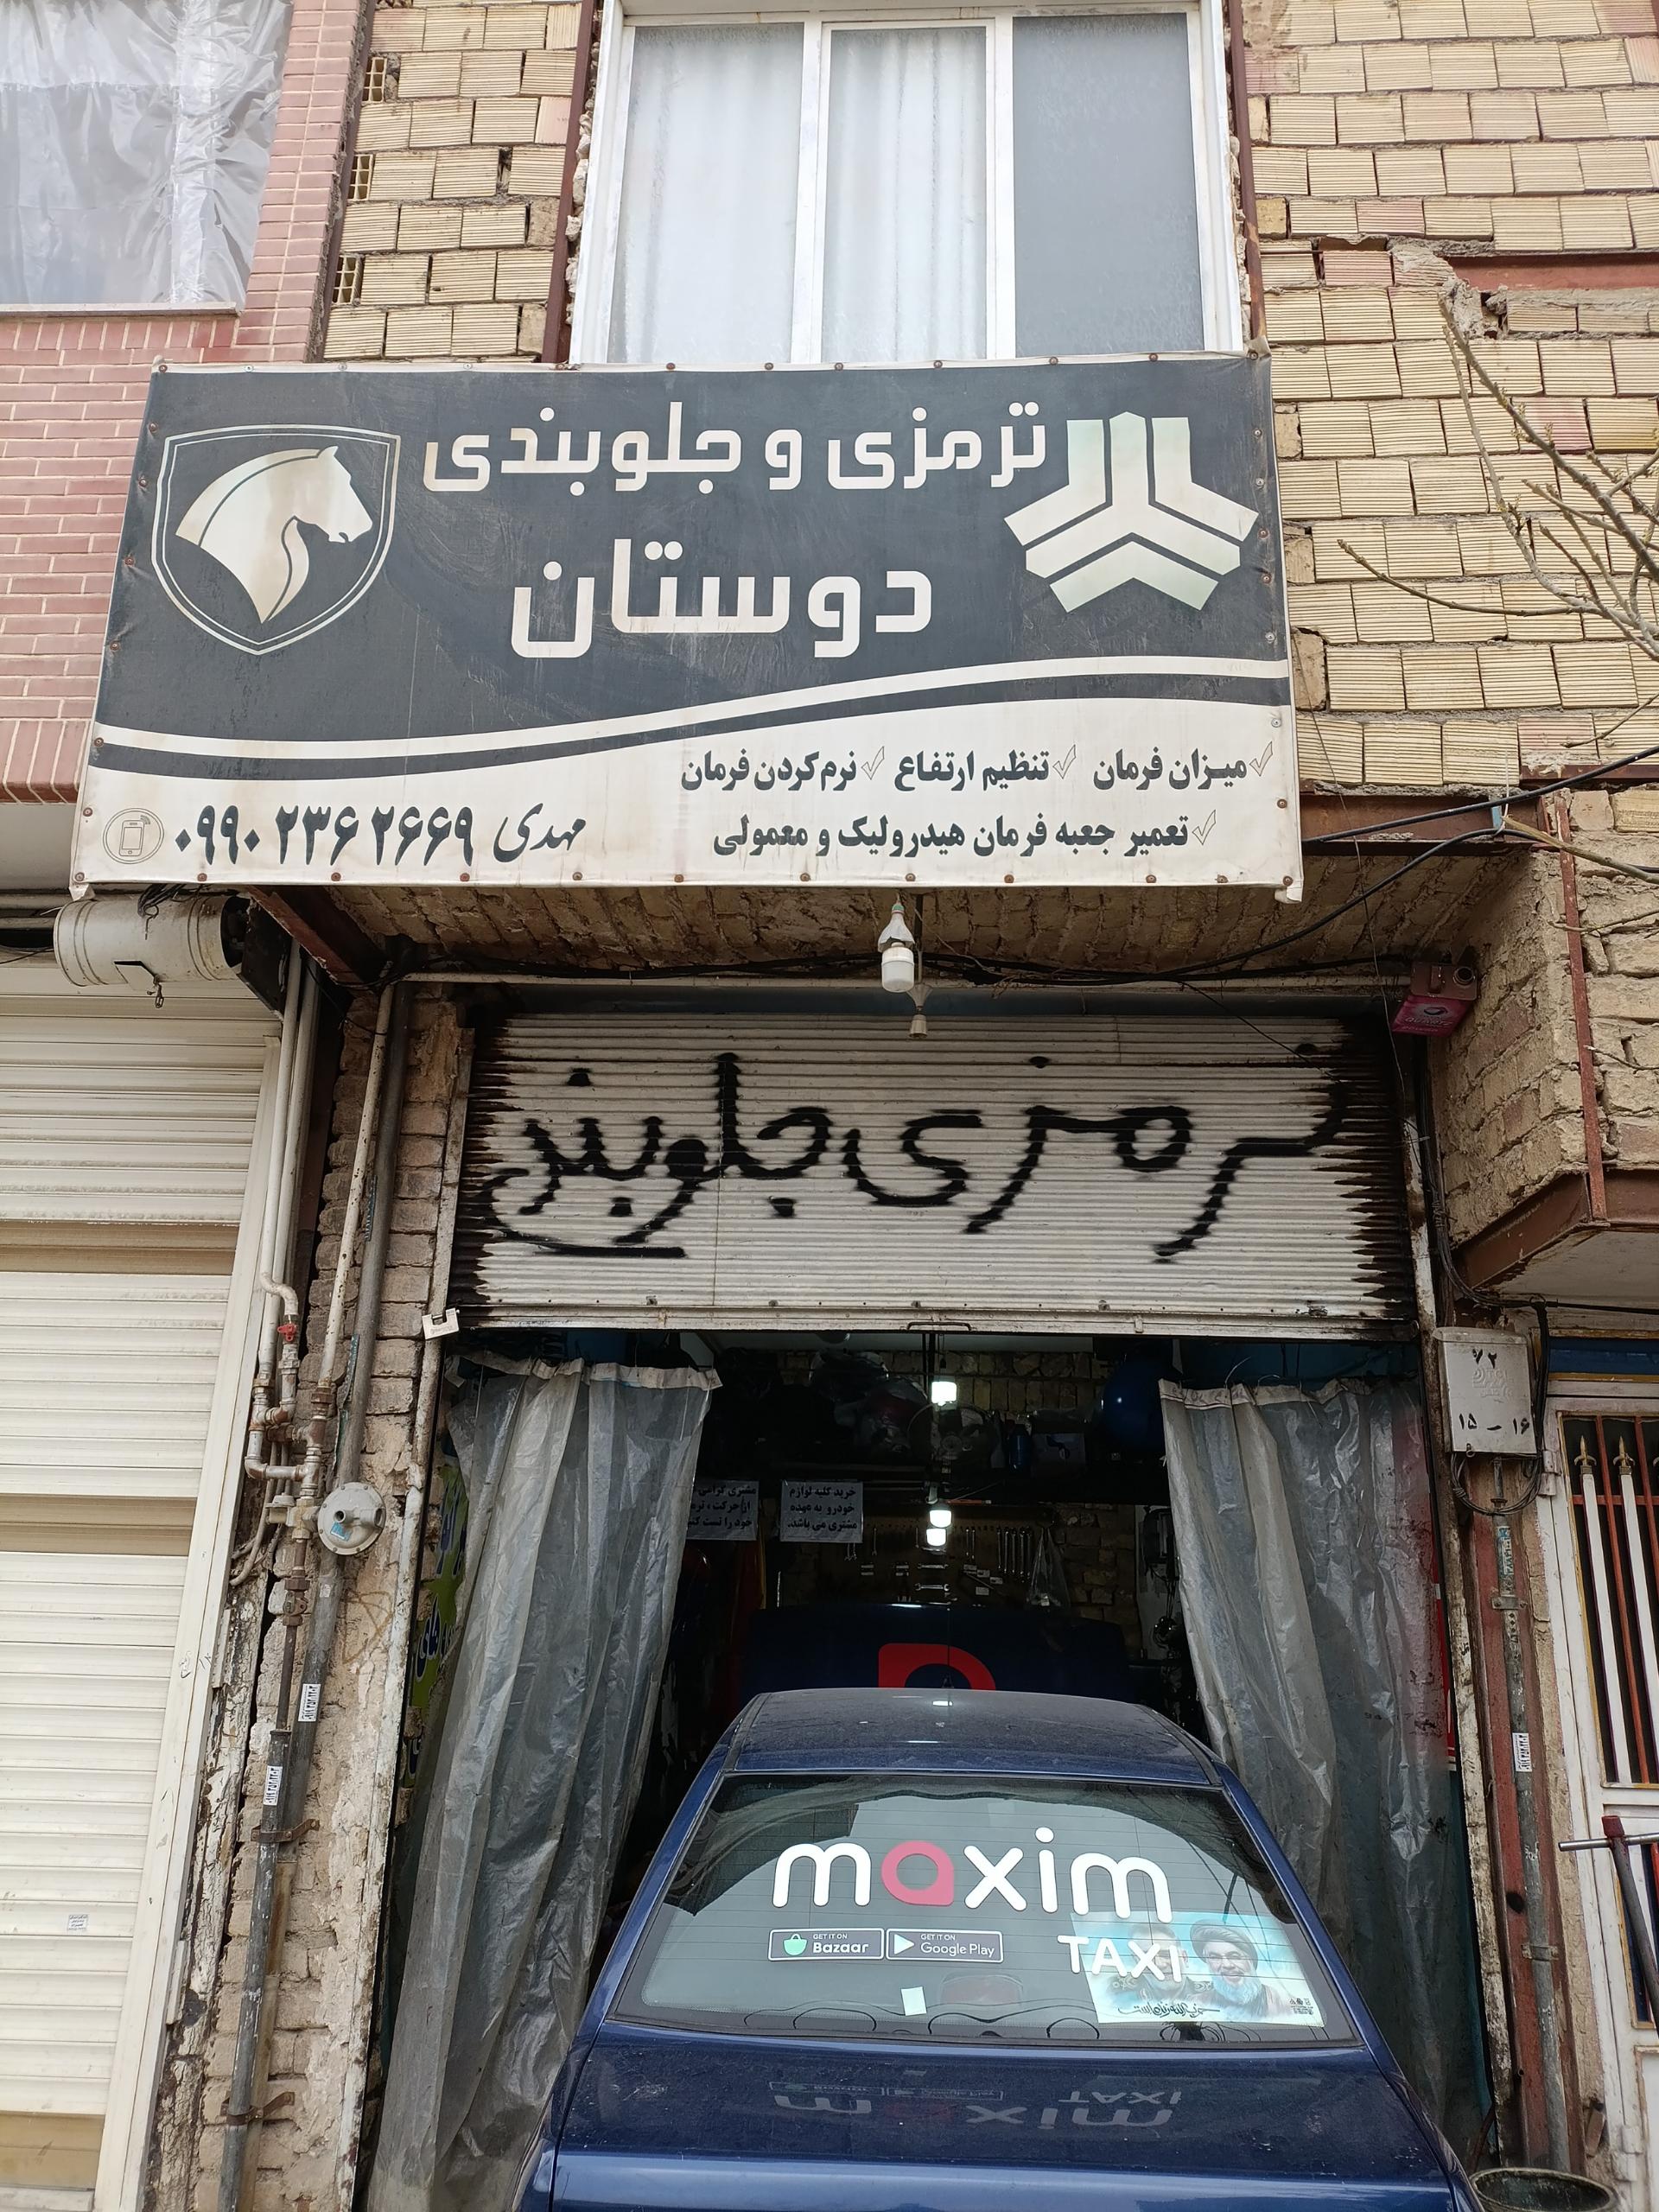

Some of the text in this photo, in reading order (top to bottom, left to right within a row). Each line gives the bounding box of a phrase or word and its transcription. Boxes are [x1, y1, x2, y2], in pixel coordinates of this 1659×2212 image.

[423, 401, 1046, 497] ترمزی و جلوبندی
[511, 538, 932, 659] دوستان
[681, 747, 750, 791] فرمان
[893, 749, 1050, 792] تنظیم ارتفاع
[1093, 746, 1163, 791] فرمان
[493, 803, 587, 863] مهدی
[713, 812, 1189, 858] تعمیر جعبه فرمان هیدرولیک و معمولی
[789, 1484, 856, 1499] خرید کلیه لوازم
[826, 1503, 855, 1516] خودرو
[725, 1517, 733, 1529] را
[734, 1517, 753, 1529] خود
[828, 1519, 858, 1532] مشتری
[772, 1826, 1173, 1923] maxim
[812, 1942, 869, 1954] Bazaar
[920, 1942, 995, 1958] Google Play
[1056, 1934, 1183, 1983] TAXI
